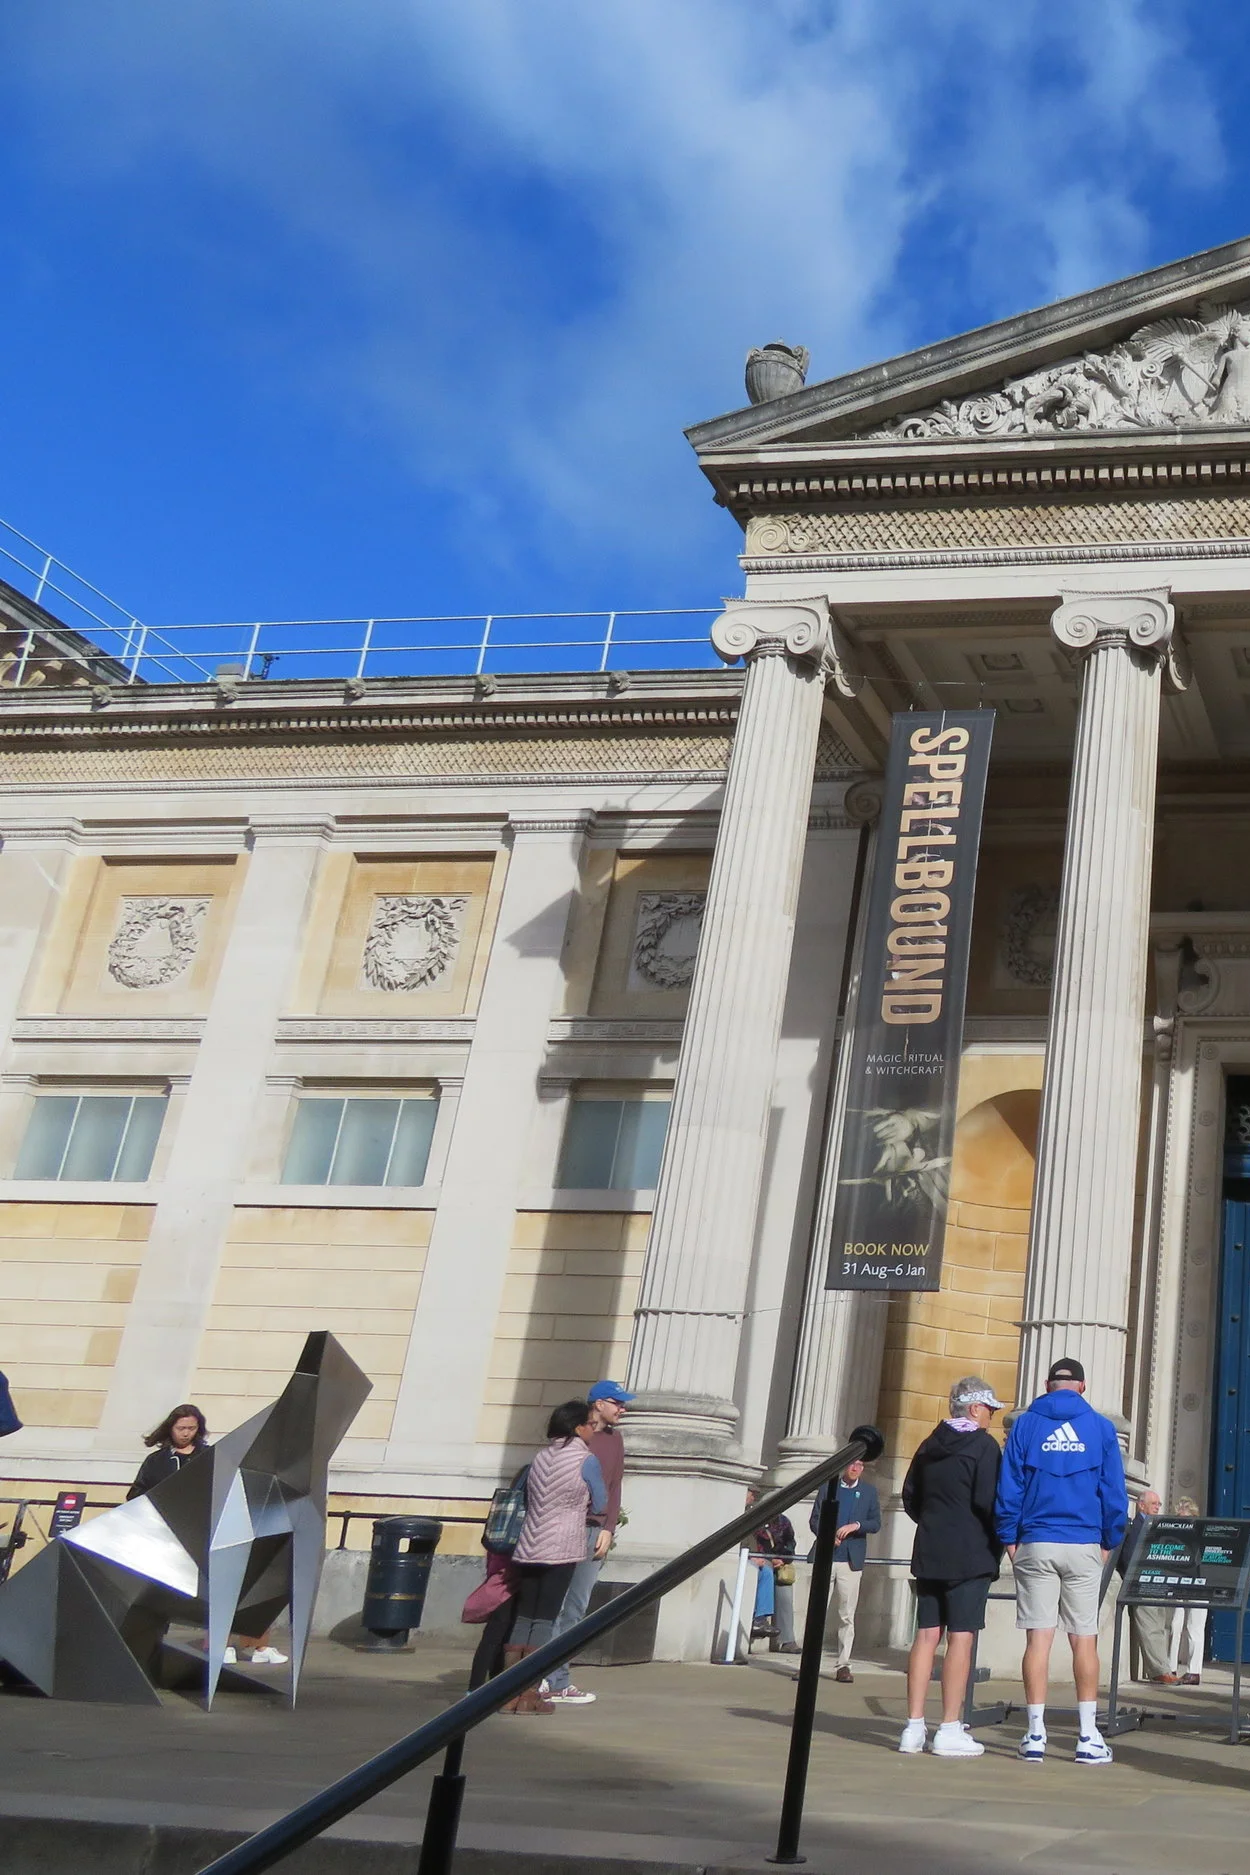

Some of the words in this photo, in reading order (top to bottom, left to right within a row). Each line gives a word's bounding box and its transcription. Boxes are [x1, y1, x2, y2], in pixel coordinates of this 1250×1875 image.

[881, 727, 970, 1025] SPELLBOUND
[866, 1054, 902, 1063] MAGIC
[908, 1053, 945, 1062] RITUAL
[864, 1065, 872, 1075] &
[876, 1065, 945, 1075] WITCHCRAFT
[843, 1242, 887, 1256] BOOK
[890, 1243, 930, 1256] NOW
[842, 1262, 857, 1275] 31
[905, 1263, 926, 1276] Jan
[1041, 1439, 1086, 1452] adidas
[1150, 1543, 1186, 1551] WELCOME
[1146, 1554, 1191, 1562] ASHMOLEAN
